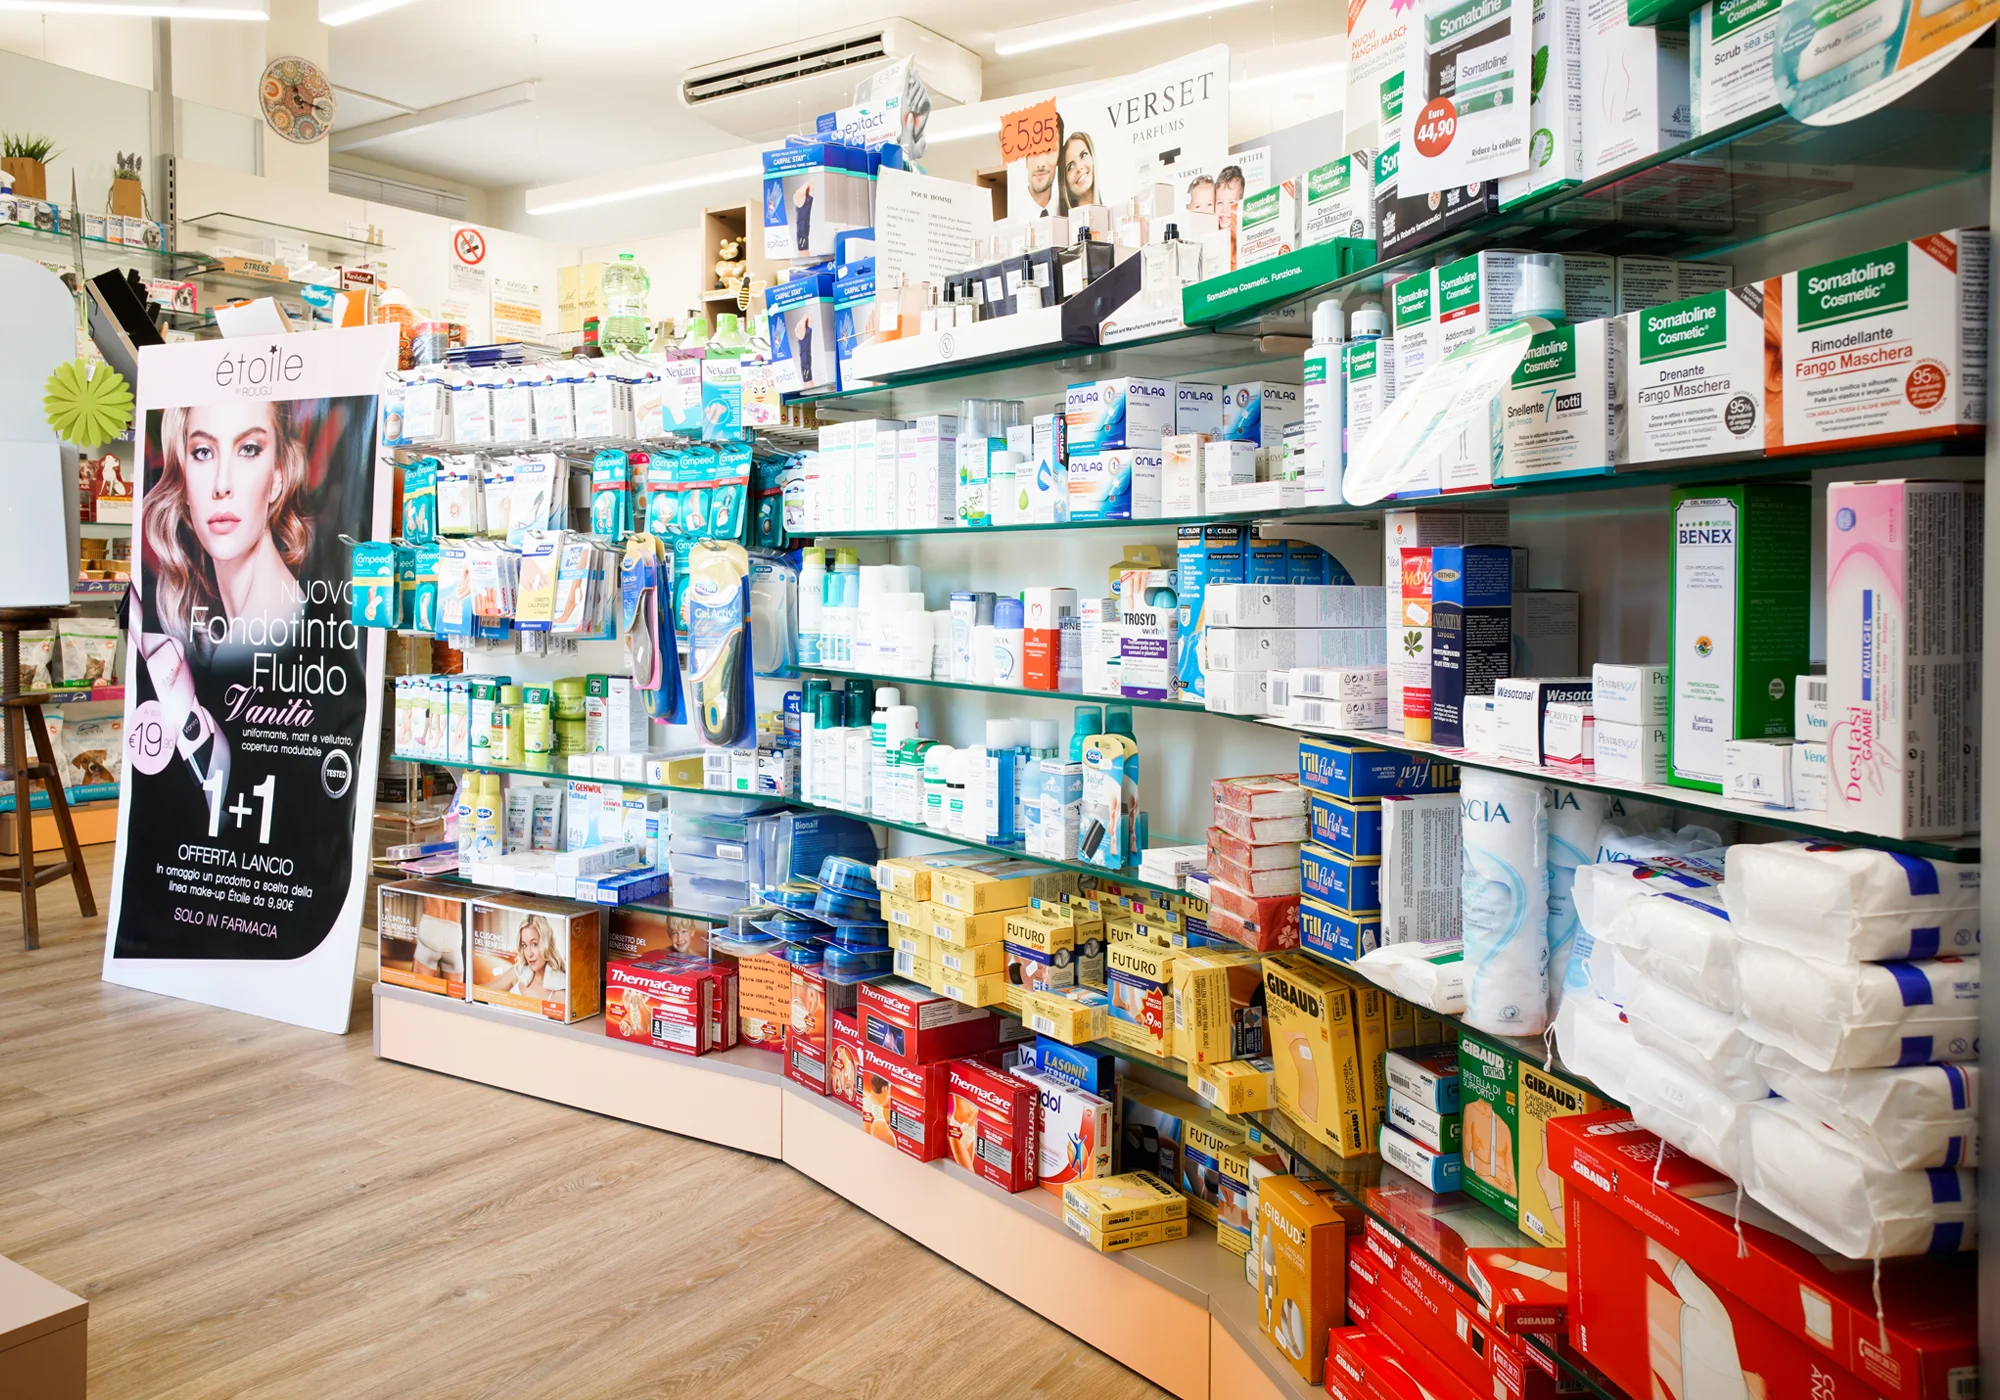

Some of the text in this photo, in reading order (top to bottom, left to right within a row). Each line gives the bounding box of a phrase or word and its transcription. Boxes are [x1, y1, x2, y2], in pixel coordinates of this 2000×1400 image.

[1728, 1, 1768, 23] Cosmetic
[1352, 29, 1376, 49] NUOVI
[1352, 43, 1379, 62] FANGHI
[1714, 38, 1760, 65] Scrub sea
[1462, 54, 1507, 78] Somatoline
[1107, 72, 1214, 128] VERSET
[1428, 107, 1444, 120] Euro
[846, 113, 884, 137] epitact
[1017, 117, 1055, 151] 5,95
[1132, 119, 1185, 144] PARFUMS
[1417, 117, 1454, 142] 44,90
[1239, 153, 1264, 164] PETITE
[1472, 138, 1521, 157] Riduce la cellulite
[1178, 167, 1203, 178] VERSET
[1312, 165, 1346, 184] Somatoline
[911, 191, 927, 199] POUR
[1317, 201, 1340, 216] Drenante
[1307, 209, 1352, 231] Fango Maschera
[767, 239, 789, 249] epitact
[244, 262, 269, 273] STRESS
[1808, 261, 1895, 294] Somatoline
[1207, 266, 1302, 302] Somatoline Cosmetic. Funziona.
[1440, 270, 1477, 291] Somatoline
[1397, 288, 1428, 306] Somatoline
[1446, 286, 1471, 300] Cosmetic
[1821, 284, 1881, 310] Cosmetic
[1452, 310, 1466, 319] UOMO
[1648, 305, 1716, 332] Somatoline
[1404, 331, 1424, 342] Drenante
[1446, 327, 1476, 342] Addominali
[1658, 326, 1705, 345] Cosmetic
[1812, 327, 1893, 354] Rimodellante
[216, 345, 303, 386] étoile
[1351, 352, 1375, 364] Somatoline
[1524, 360, 1559, 374] Cosmetic
[1796, 346, 1912, 377] Fango Maschera
[666, 364, 696, 378] Nexcare
[706, 364, 737, 376] Nexcare
[1659, 365, 1704, 382] Drenante
[1913, 368, 1940, 384] 95%
[1068, 393, 1099, 405] ONILAQ
[1130, 385, 1165, 397] ONILAQ
[1179, 391, 1213, 401] ONILAQ
[1264, 389, 1295, 400] ONILAQ
[1638, 379, 1730, 404] Fango Maschera
[1508, 402, 1544, 418] Snellente
[1541, 389, 1580, 423] 7 notti
[1730, 401, 1751, 414] 95%
[595, 458, 623, 472] Compeed
[680, 455, 715, 468] Compeed
[719, 452, 749, 466] Compeed
[1071, 462, 1103, 473] ONILAQ
[1679, 529, 1732, 544] BENEX
[355, 553, 391, 566] Compeed
[189, 606, 358, 650] Fondotinta
[1124, 613, 1156, 625] TROSYD
[1863, 618, 1872, 679] EMULGEL
[252, 653, 347, 695] Fluido
[1497, 686, 1533, 701] Wasotonal
[225, 683, 315, 728] Vanità
[243, 728, 353, 747] uniformante, matt vellutato,
[1863, 708, 1873, 760] GAMBE
[241, 742, 321, 757] copertura modulabile
[1846, 706, 1862, 803] Destasi
[1301, 751, 1318, 773] Till
[326, 769, 347, 778] TESTED
[575, 784, 602, 794] GEHWOL
[203, 769, 275, 844] 1+1
[1313, 805, 1328, 827] Till
[178, 844, 293, 876] OFFERTA LANCIO
[1302, 859, 1319, 880] Till
[156, 863, 312, 898] In omaggio un prodotto a scelta della
[169, 880, 265, 907] linea make-up Étoile da
[174, 907, 277, 938] SOLO IN FARMACIA
[1007, 923, 1045, 944] FUTURO
[1301, 914, 1321, 939] Till
[1031, 943, 1044, 951] SPORT
[1112, 953, 1156, 976] FUTURO
[611, 969, 691, 995] ThermaCare
[861, 985, 911, 1013] ThermaCare
[1267, 972, 1319, 1019] GIBAUD
[1461, 1038, 1505, 1069] GIBAUD
[865, 1050, 923, 1084] ThermaCare
[1044, 1051, 1087, 1081] LASONIL
[1483, 1066, 1505, 1080] ORTHO
[950, 1072, 1012, 1110] ThermaCare
[1462, 1068, 1500, 1096] BRETELLA DI
[1462, 1079, 1495, 1102] SUPPORTO
[1524, 1073, 1576, 1111] GIBAUD
[1524, 1090, 1557, 1113] CAVIGLIERA
[1524, 1099, 1551, 1118] CALZINO
[1524, 1107, 1543, 1123] CAMEL
[1027, 1092, 1038, 1182] ThermaCare
[1325, 1128, 1339, 1142] DUAL
[1136, 1173, 1172, 1196] GIBAUD
[1572, 1160, 1611, 1192] GIBAUD
[1108, 1216, 1130, 1225] GIBAUD
[1264, 1201, 1300, 1245] GIBAUD
[1108, 1237, 1130, 1246] GIBAUD
[1367, 1239, 1394, 1269] GIBAUD
[1351, 1260, 1374, 1285] GIBAUD
[1401, 1264, 1421, 1289] CINTURA
[1401, 1274, 1424, 1301] NORMALE
[1517, 1317, 1555, 1325] GIBAUD
[1336, 1353, 1360, 1382] GIBAUD
